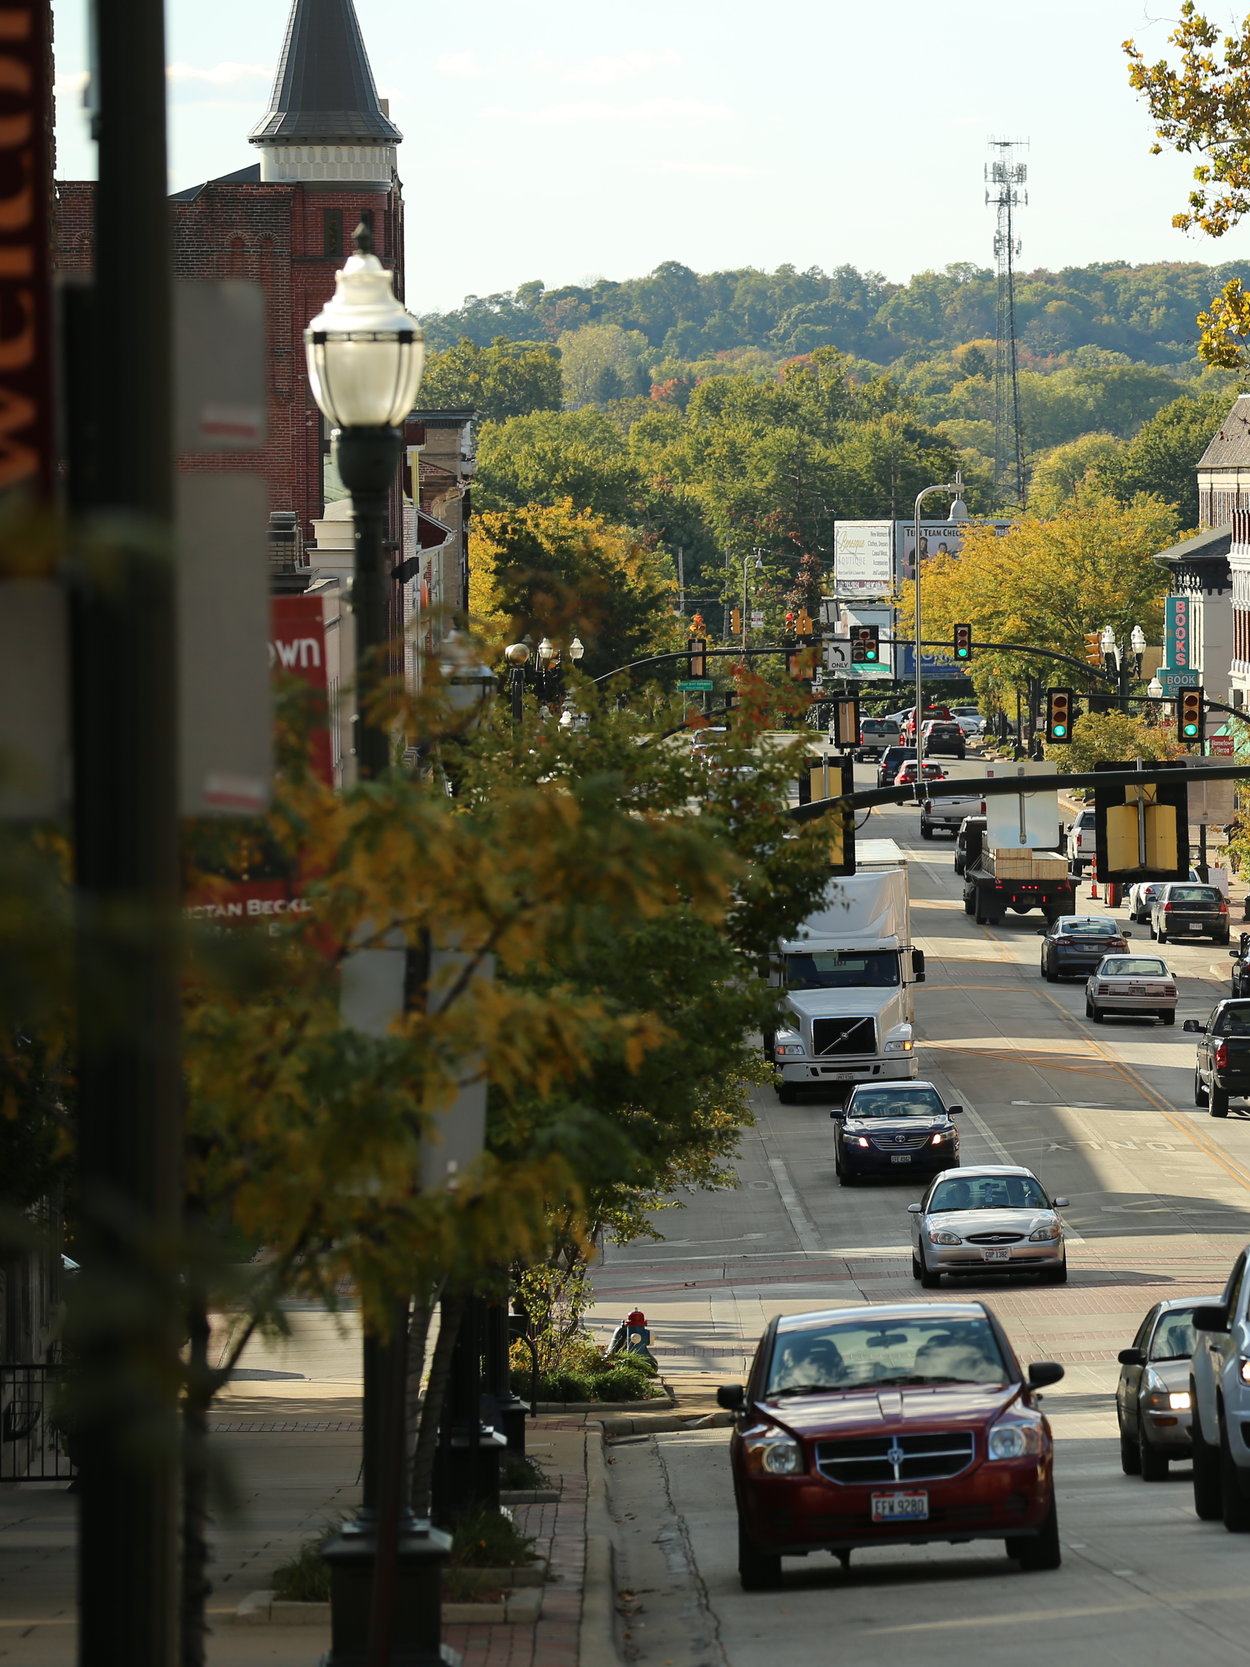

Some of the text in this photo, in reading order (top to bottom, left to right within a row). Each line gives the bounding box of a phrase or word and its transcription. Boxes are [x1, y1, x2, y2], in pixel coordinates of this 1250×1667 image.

[907, 528, 922, 536] TEN
[924, 528, 941, 536] TEAM
[1175, 601, 1186, 666] BOOKS
[1167, 676, 1195, 684] BOOK
